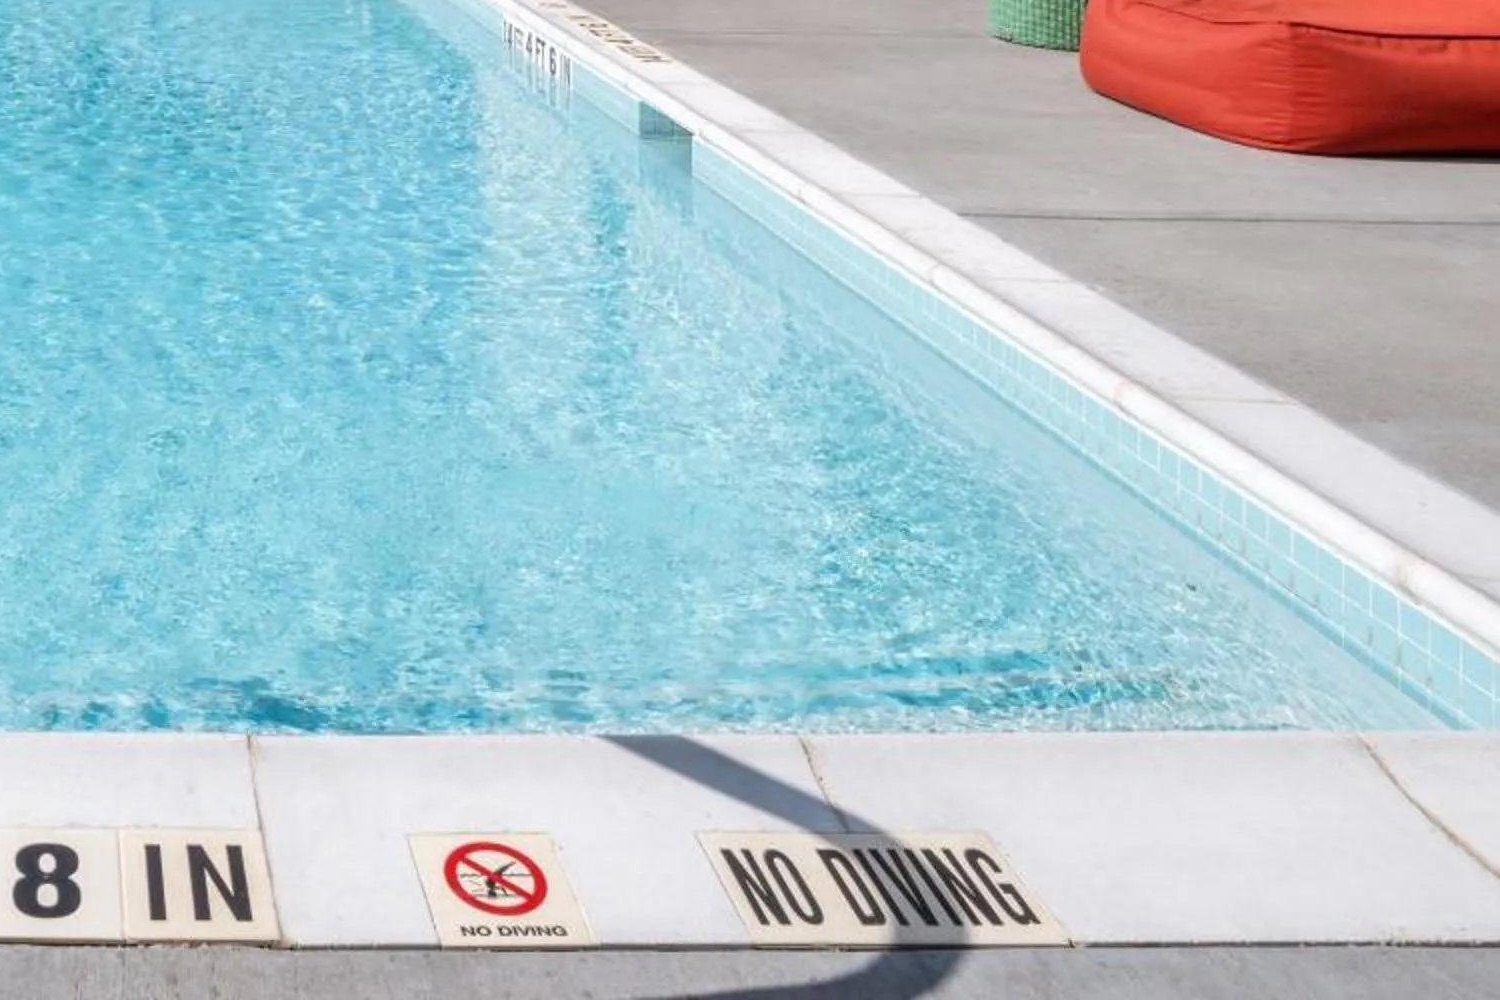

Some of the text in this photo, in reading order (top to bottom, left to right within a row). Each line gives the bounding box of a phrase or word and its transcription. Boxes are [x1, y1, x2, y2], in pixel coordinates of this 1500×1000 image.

[535, 37, 547, 70] FT
[549, 47, 557, 76] 6
[12, 842, 82, 918] 8
[144, 843, 253, 921] IN
[720, 848, 1041, 926] NO DIVING
[460, 925, 568, 937] NO DIVING
